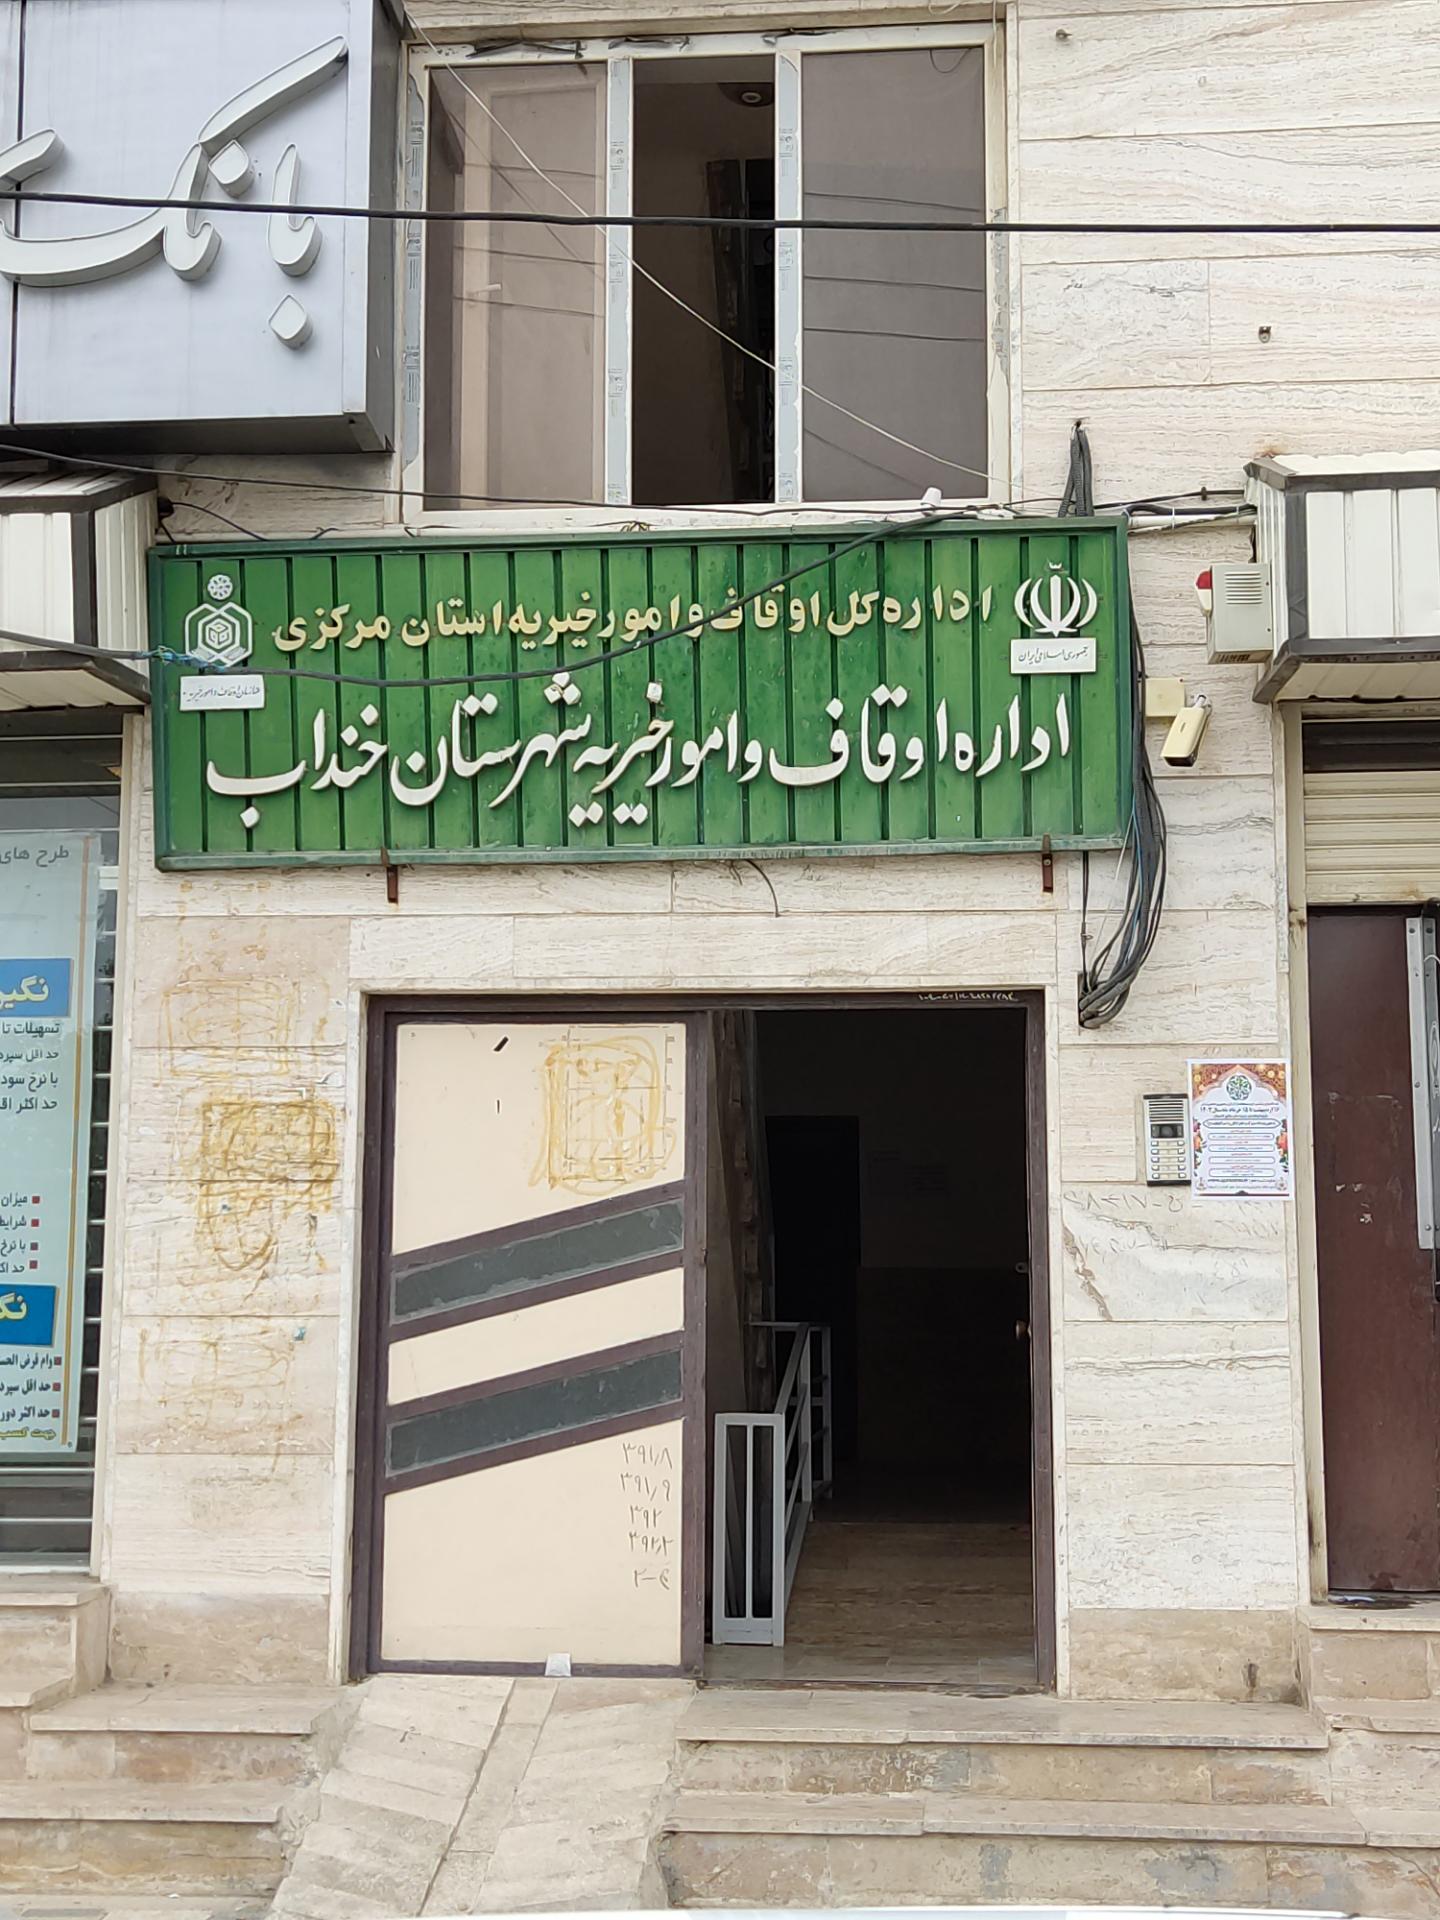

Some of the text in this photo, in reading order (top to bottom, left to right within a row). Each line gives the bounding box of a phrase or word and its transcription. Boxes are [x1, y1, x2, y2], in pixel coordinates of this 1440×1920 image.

[0, 35, 348, 349] بانک
[272, 583, 993, 652] اداره کل اوقاف و امور خیریه استان مرکزی
[1018, 645, 1089, 665] جمهوری اسلامی ایران
[206, 671, 1070, 830] اداره اوقاف و امور خیریه شهرستان خنداب
[36, 845, 69, 868] طرح
[0, 975, 49, 1009] نگی
[2, 1021, 60, 1038] تسهیلات تا
[1, 1072, 58, 1092] با نرخ سود
[1, 1192, 28, 1208] میزان
[0, 1239, 26, 1257] با نرخ
